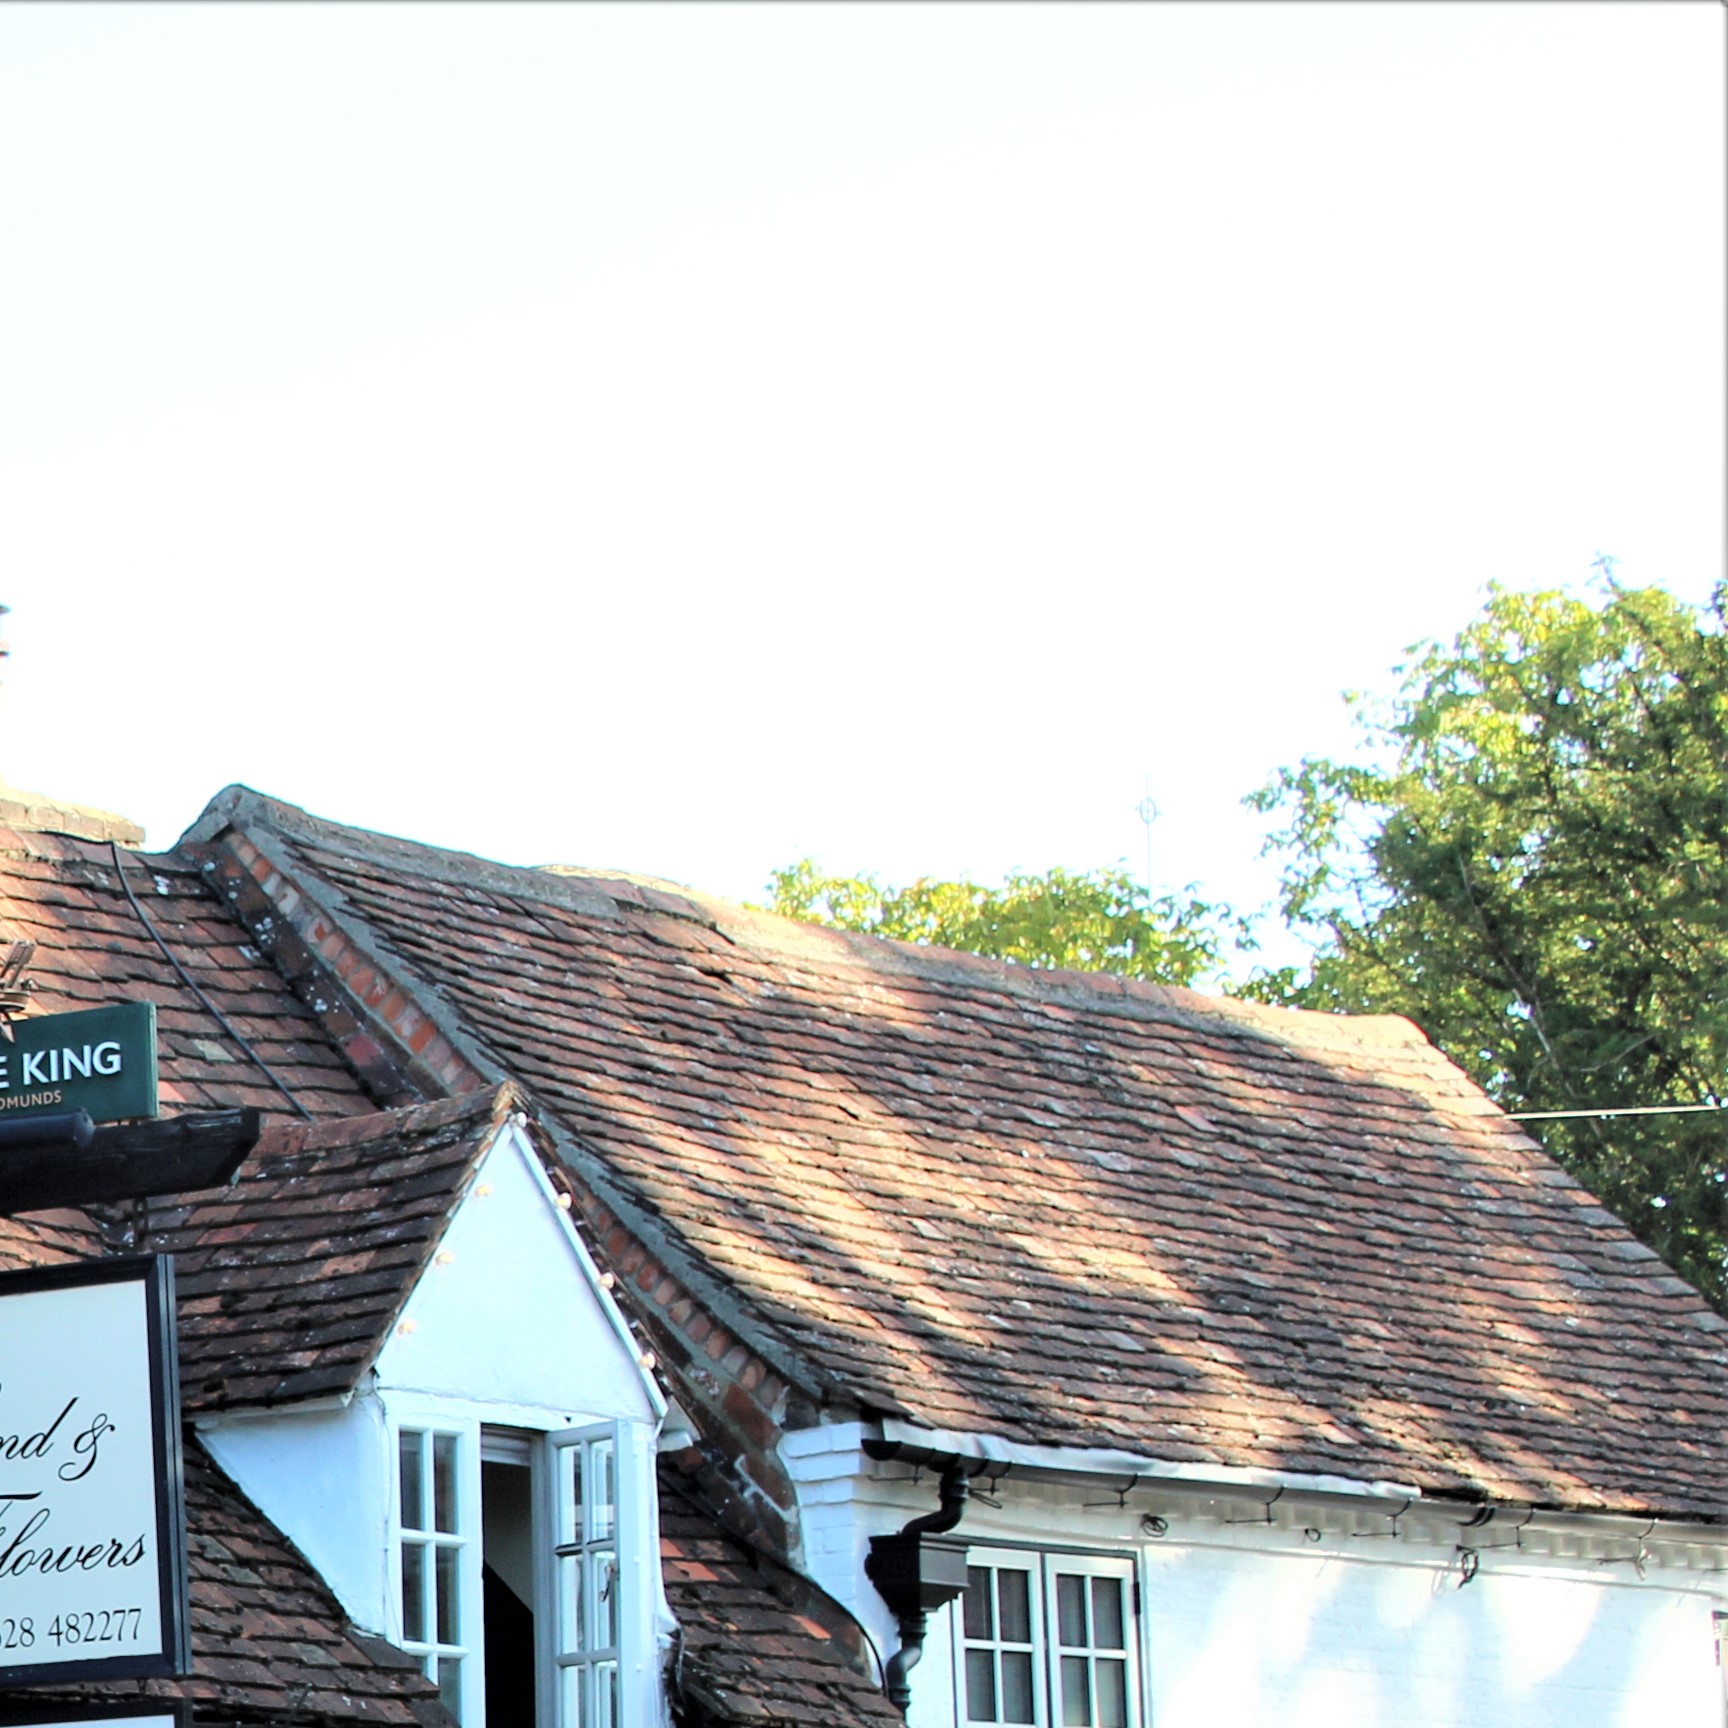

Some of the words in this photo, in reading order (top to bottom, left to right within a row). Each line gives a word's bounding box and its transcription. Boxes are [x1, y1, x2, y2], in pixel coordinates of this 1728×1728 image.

[22, 1041, 122, 1085] KING
[58, 1413, 116, 1482] &
[47, 1608, 142, 1647] 482277
